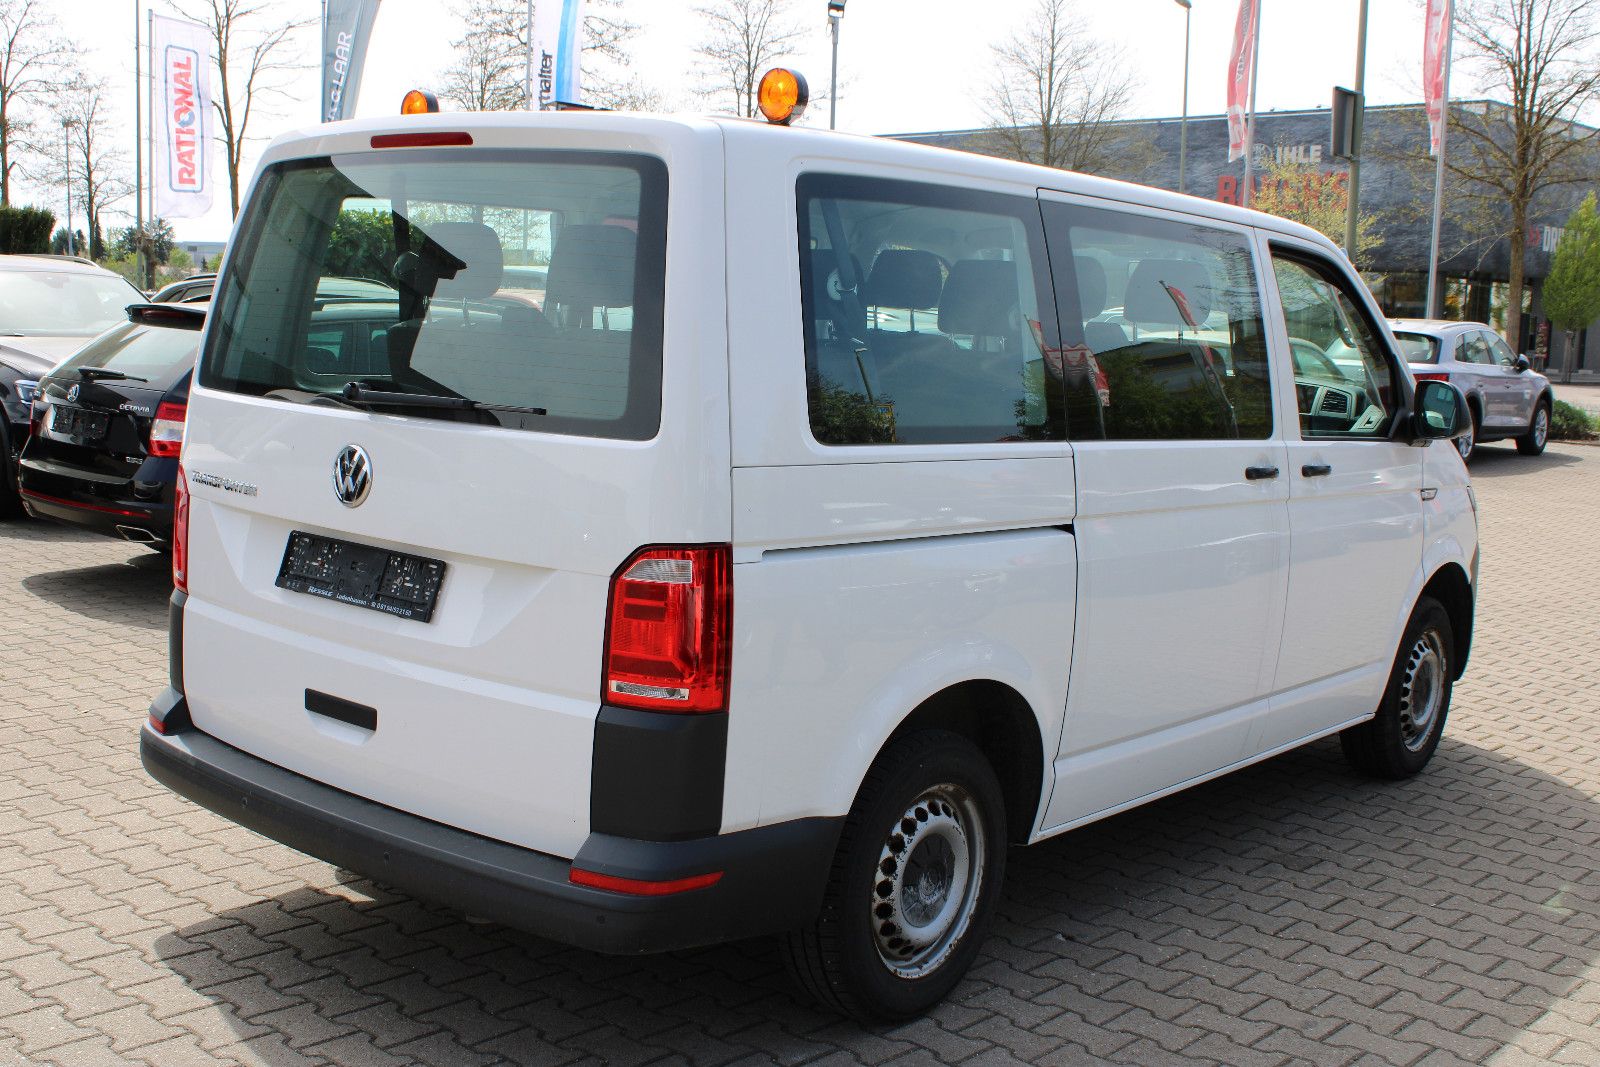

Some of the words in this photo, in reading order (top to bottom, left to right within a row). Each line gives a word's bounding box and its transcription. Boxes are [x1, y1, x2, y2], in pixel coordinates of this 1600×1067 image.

[173, 55, 197, 185] RATIONAL
[119, 403, 150, 413] OCTAVIA
[191, 470, 258, 497] TRANSPORTER
